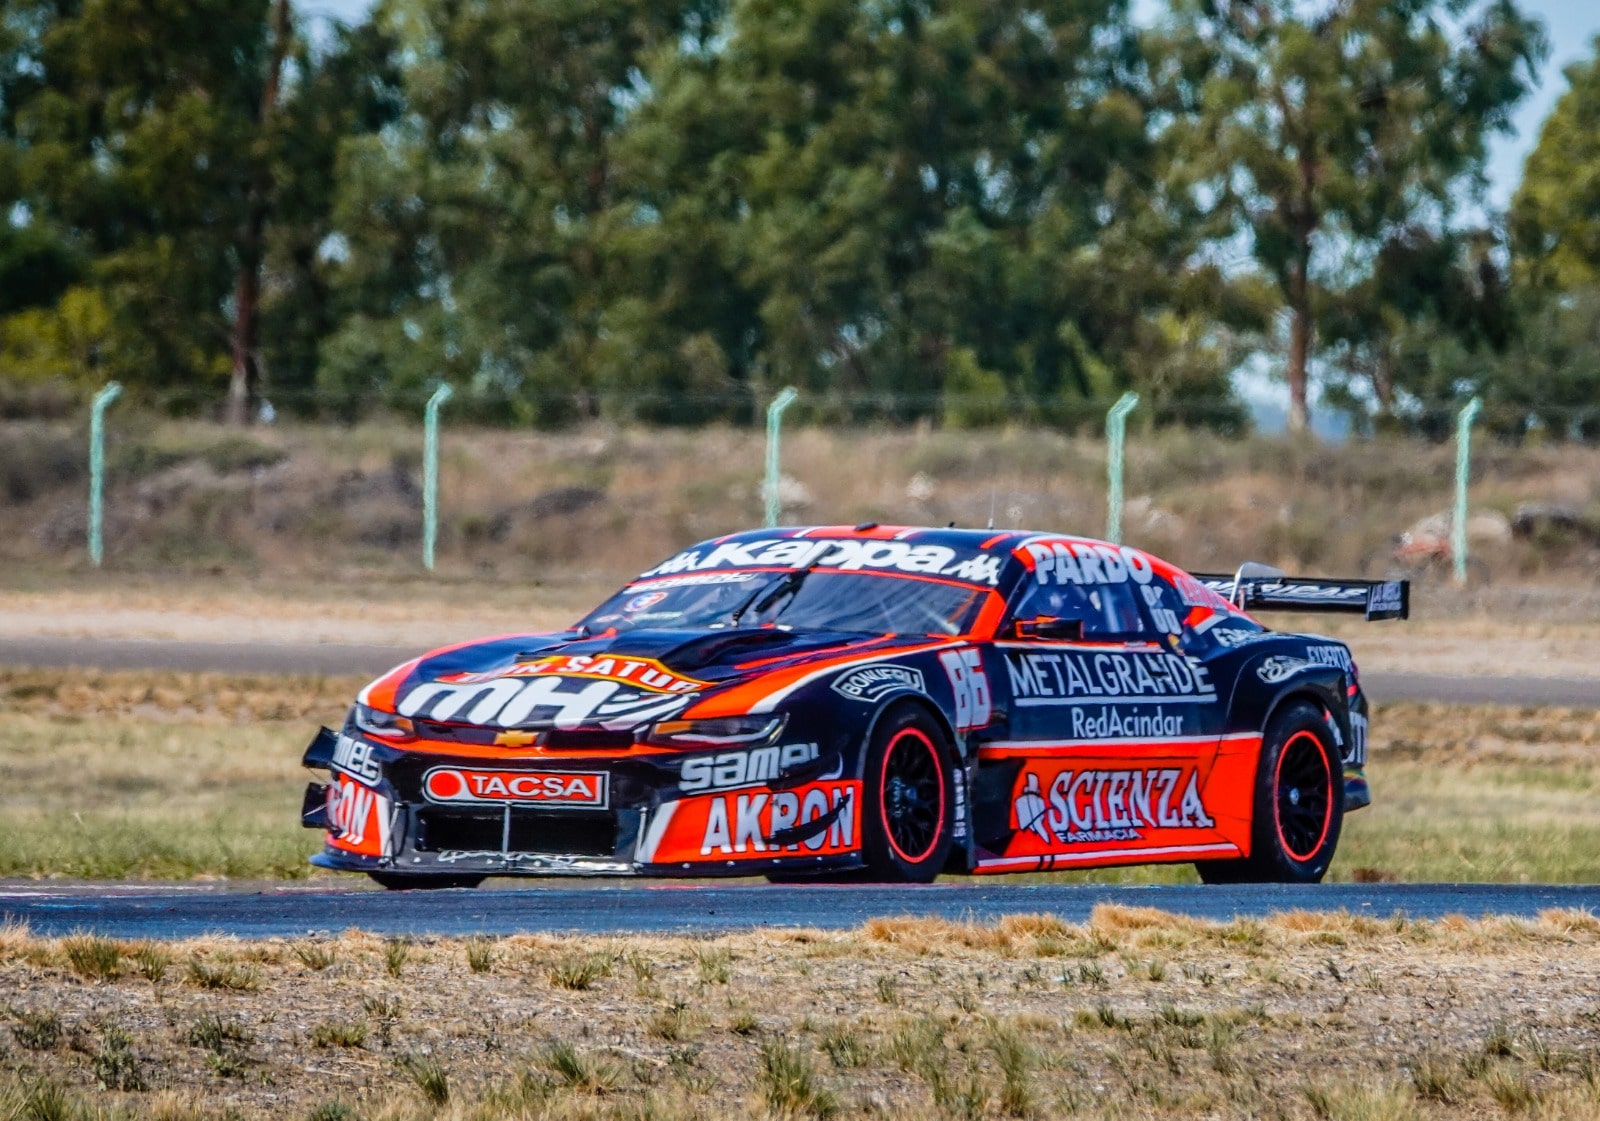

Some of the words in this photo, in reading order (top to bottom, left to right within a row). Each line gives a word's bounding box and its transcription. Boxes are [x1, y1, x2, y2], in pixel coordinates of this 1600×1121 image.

[698, 539, 957, 574] Kappa
[1032, 543, 1151, 585] PARDO
[939, 647, 991, 731] 86
[1004, 653, 1215, 697] METALGRANDE
[1071, 706, 1184, 739] RedAcindar
[472, 774, 592, 799] TACSA
[1049, 768, 1214, 830] SCIENZA
[700, 786, 854, 855] AKRON
[1055, 828, 1142, 843] FARMACIA
